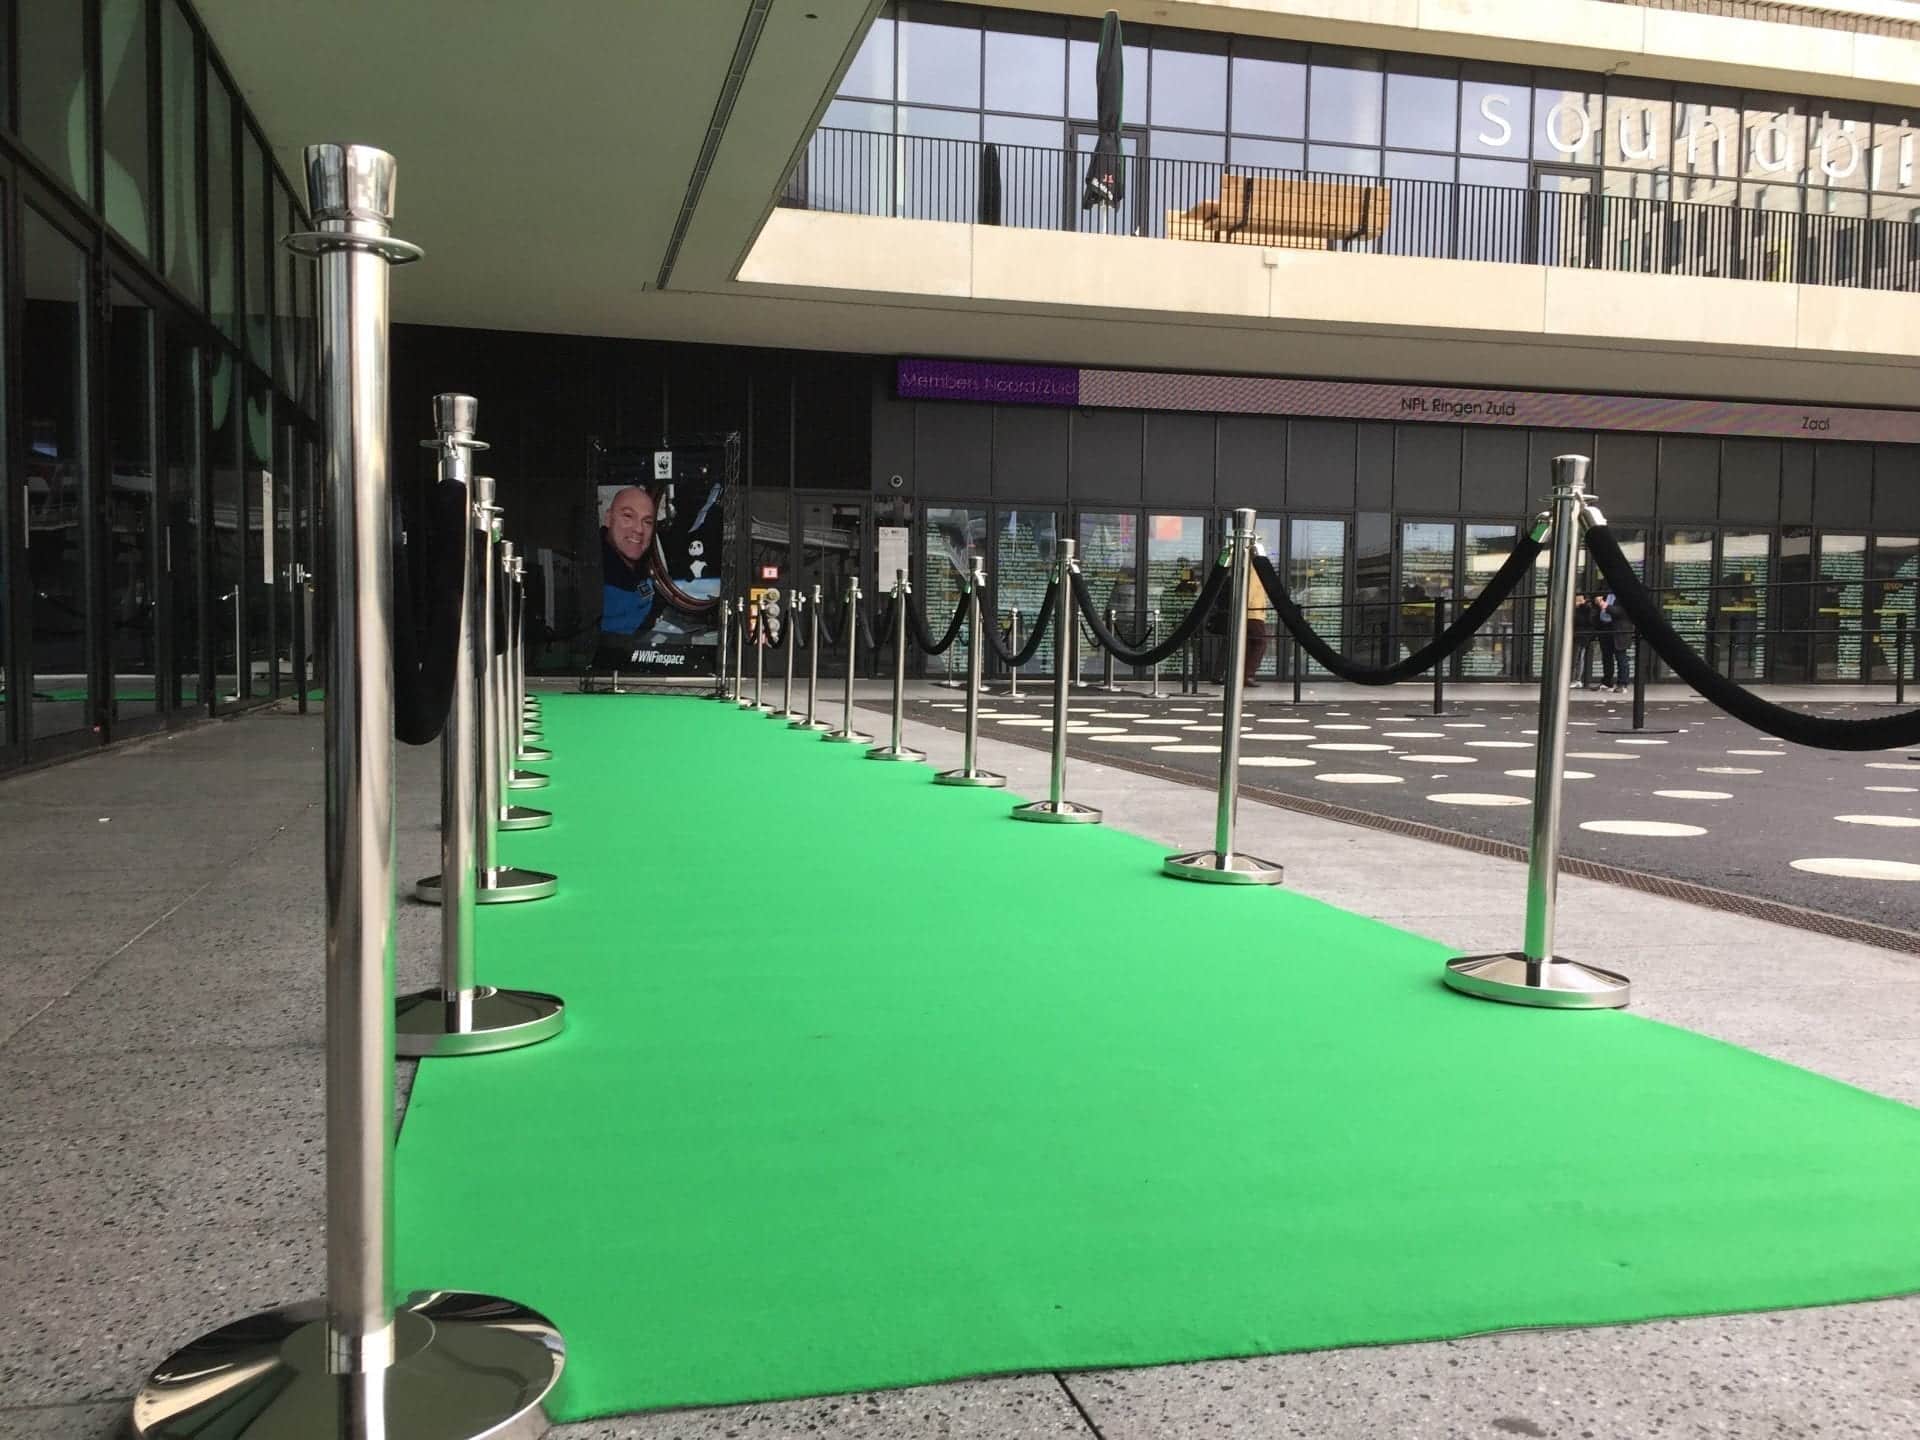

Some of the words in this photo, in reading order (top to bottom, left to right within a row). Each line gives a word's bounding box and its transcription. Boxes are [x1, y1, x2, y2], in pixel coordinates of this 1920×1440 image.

[1401, 398, 1429, 412] NPL
[1432, 399, 1482, 417] Ringen
[1486, 401, 1516, 416] Zuid
